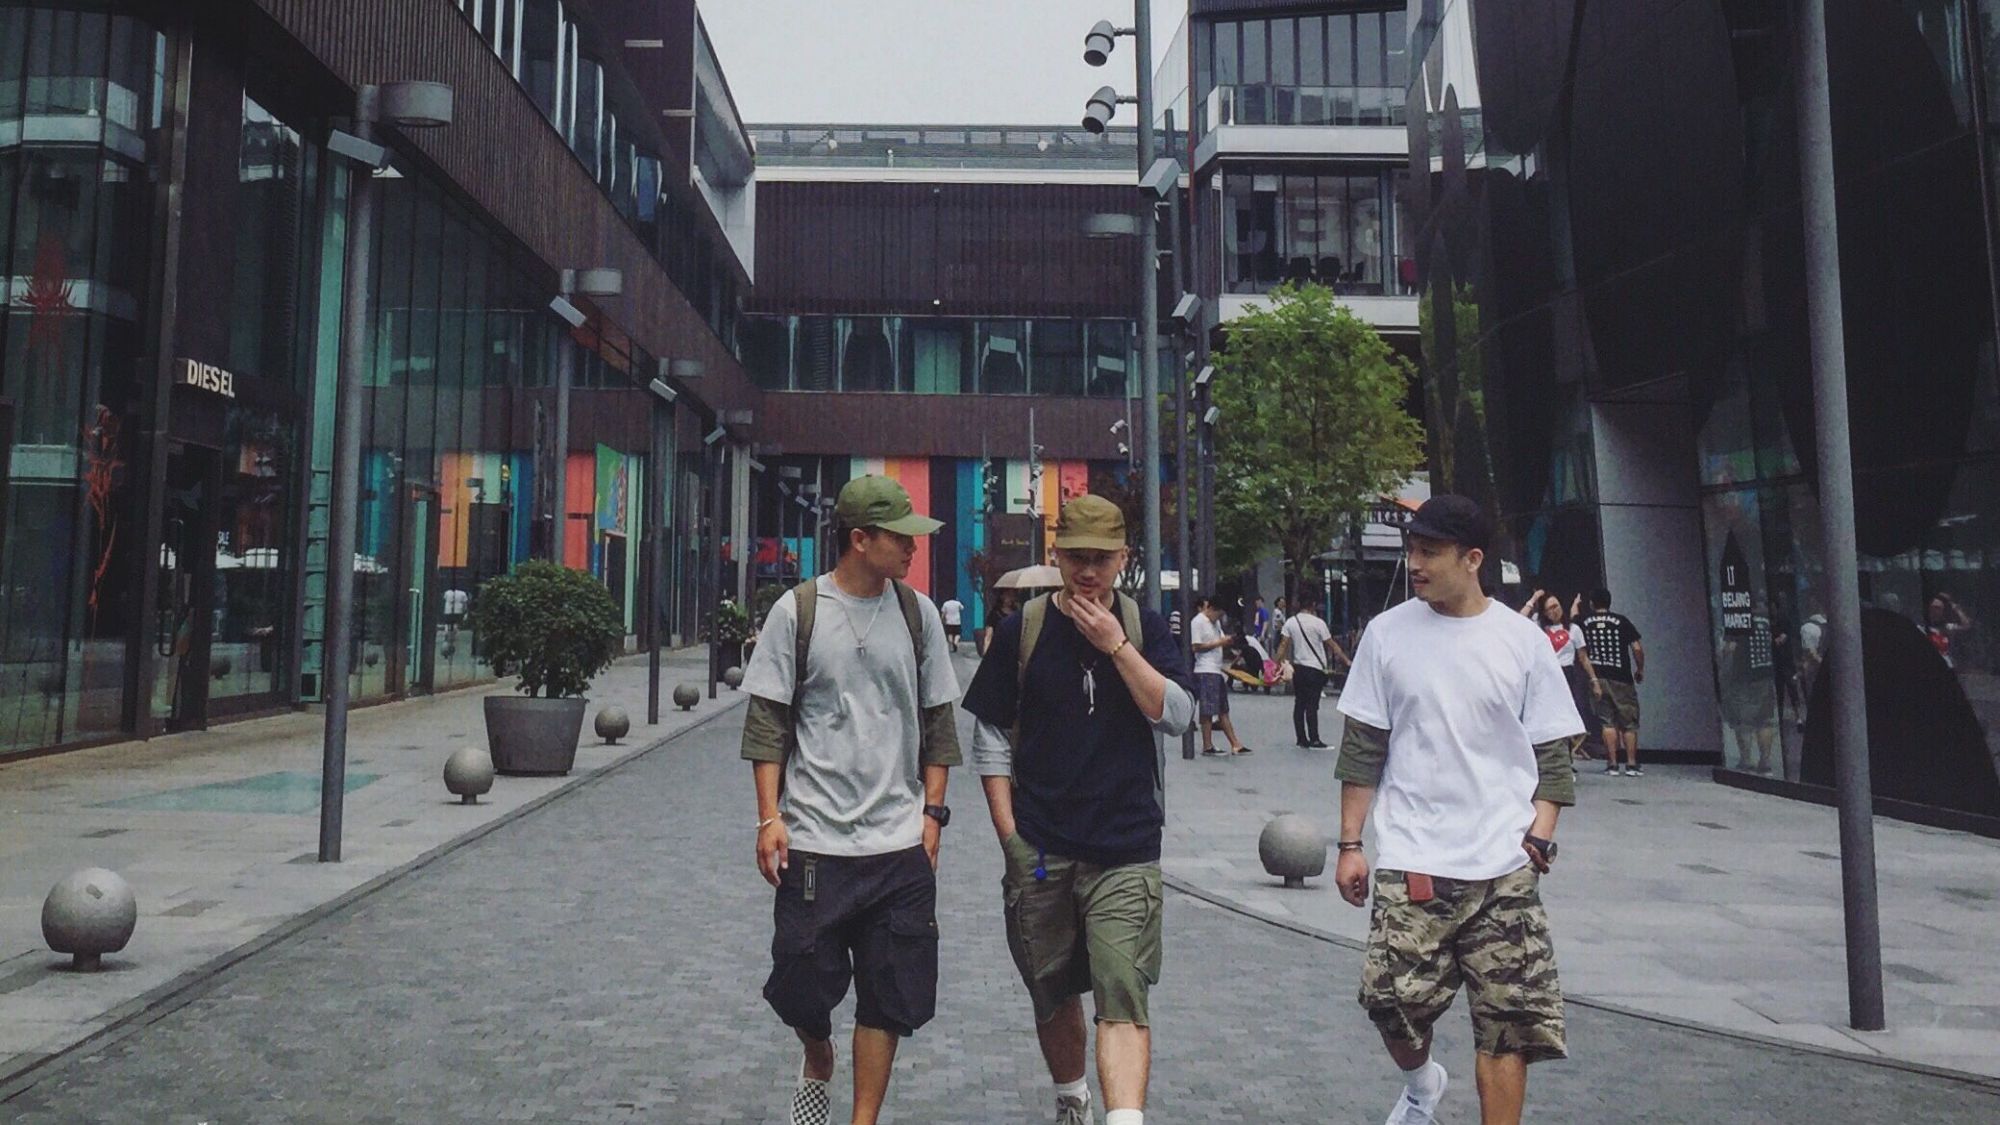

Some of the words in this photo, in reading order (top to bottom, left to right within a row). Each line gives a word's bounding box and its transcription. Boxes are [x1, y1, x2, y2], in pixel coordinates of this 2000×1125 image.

[187, 359, 235, 398] DIESEL
[1722, 591, 1751, 608] BEIJING
[1724, 613, 1752, 629] MARKET
